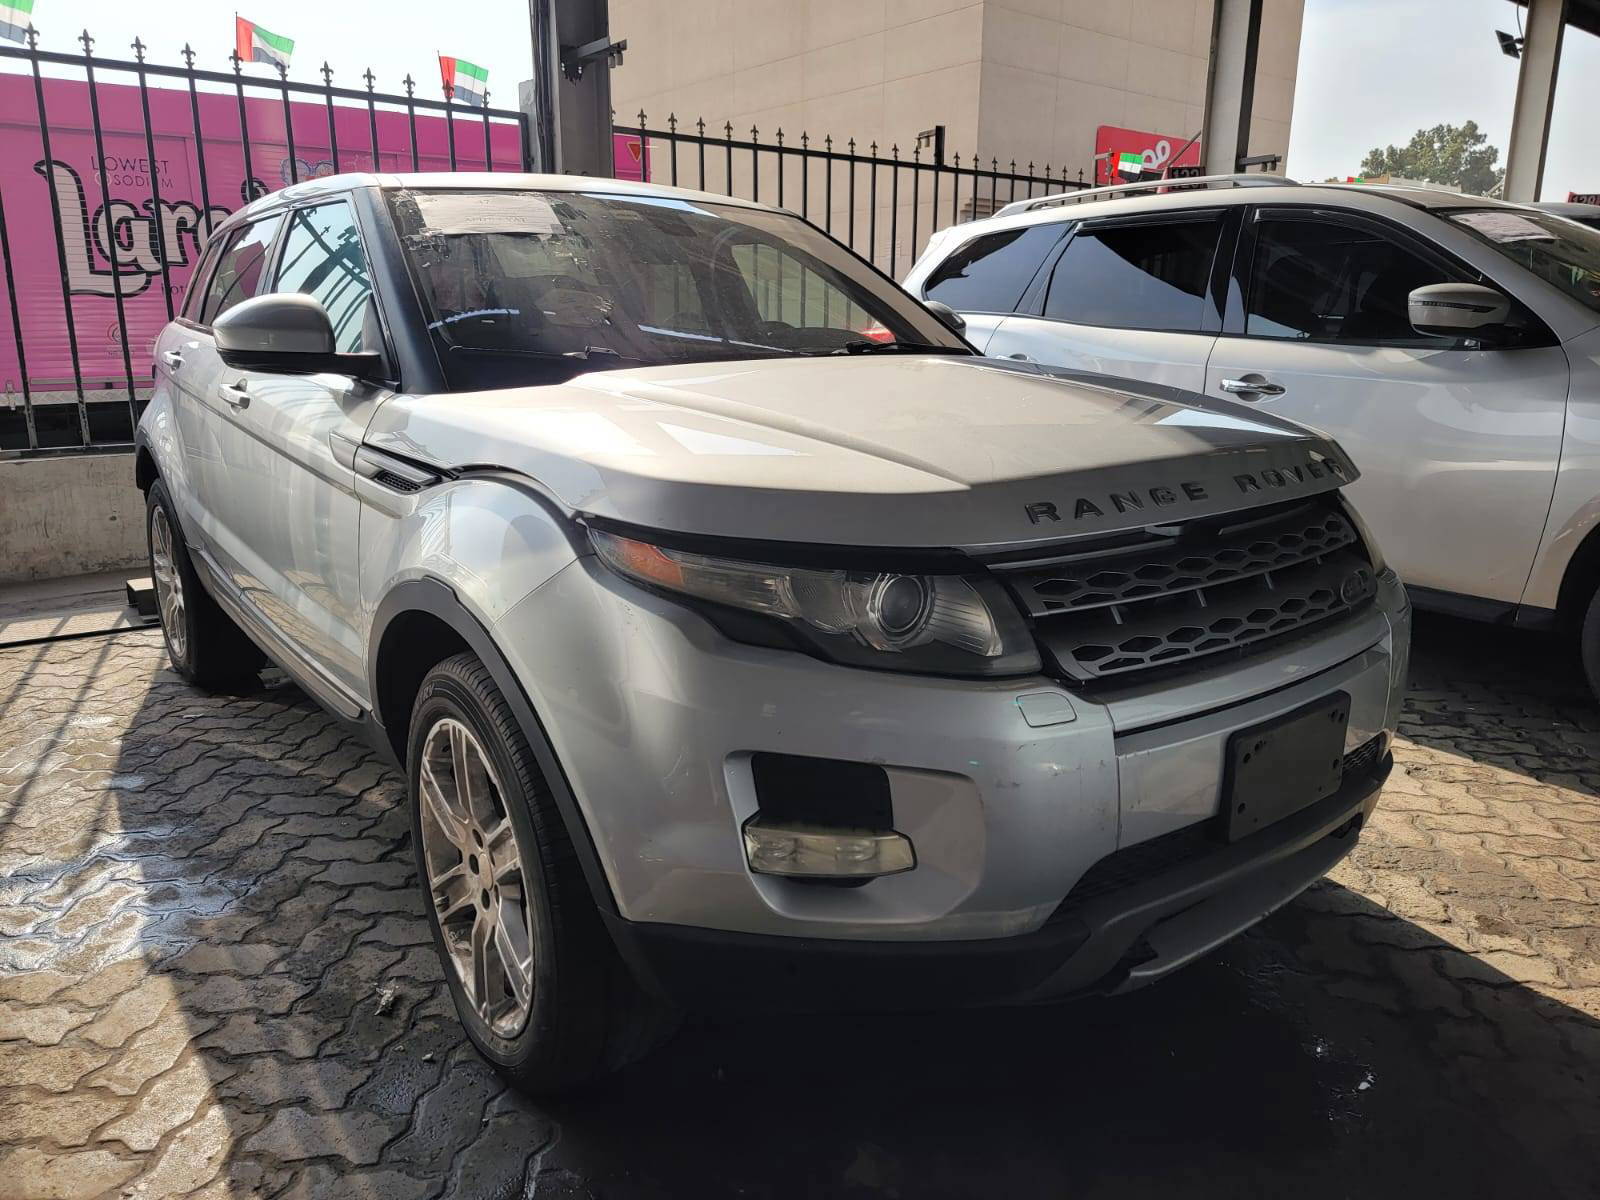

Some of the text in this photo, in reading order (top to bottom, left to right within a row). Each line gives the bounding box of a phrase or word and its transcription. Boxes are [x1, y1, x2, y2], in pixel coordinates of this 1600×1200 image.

[114, 174, 173, 188] SODIM
[1025, 458, 1349, 525] RANGE ROVER
